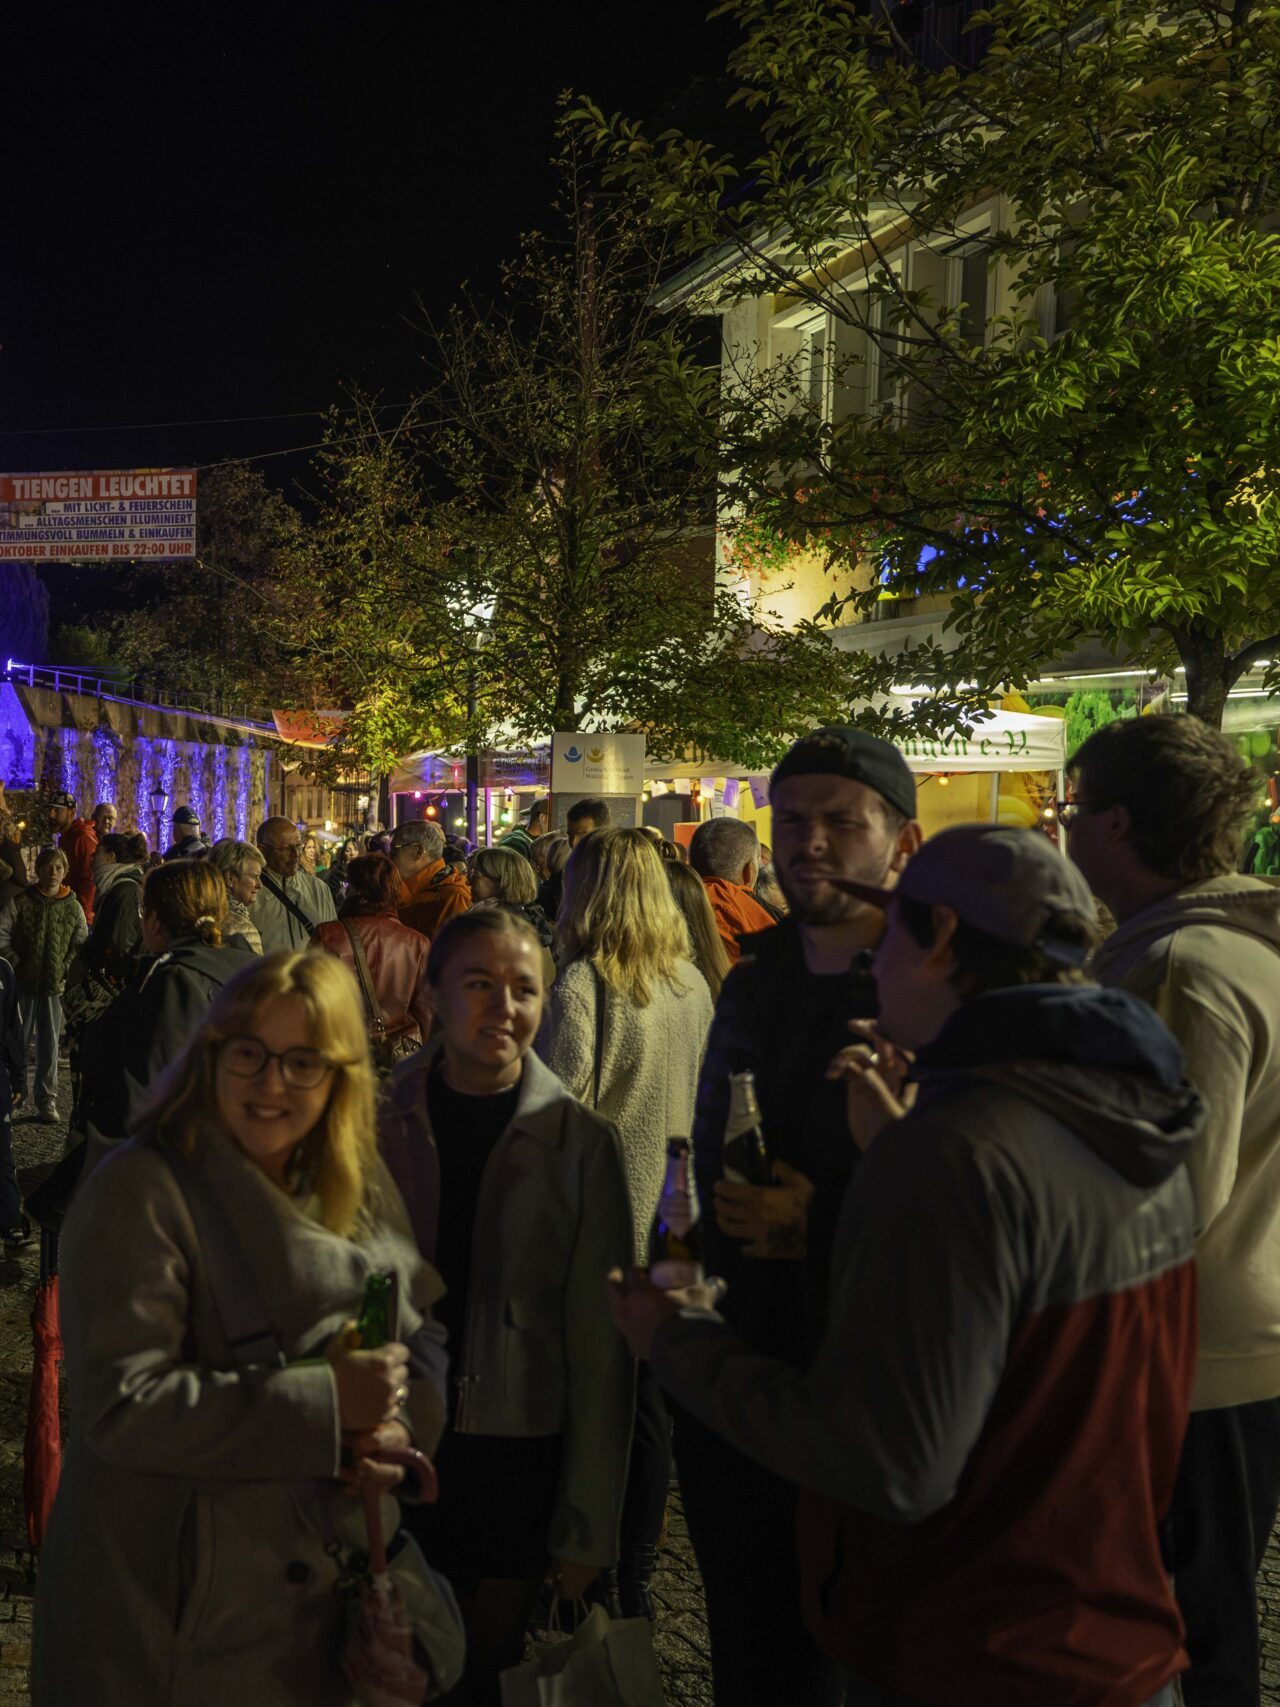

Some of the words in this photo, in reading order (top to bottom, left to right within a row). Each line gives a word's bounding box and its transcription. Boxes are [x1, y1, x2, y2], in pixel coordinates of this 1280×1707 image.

[12, 478, 93, 499] TIENGEN
[100, 474, 192, 497] LEUCHTET
[63, 502, 82, 513] MIT
[84, 501, 115, 513] LICHT-
[118, 501, 126, 512] &
[129, 499, 193, 511] FEUERSCHEIN
[36, 515, 127, 527] ALLTAGSMENSCHEN
[130, 513, 193, 525] ILLUMINIERT
[76, 528, 125, 540] BUMMELN
[128, 528, 136, 539] &
[139, 527, 193, 539] EINKAUFEN
[49, 543, 109, 556] EINKAUFEN
[112, 543, 130, 555] BIS
[133, 542, 165, 555] 22:00
[168, 542, 193, 554] UHR
